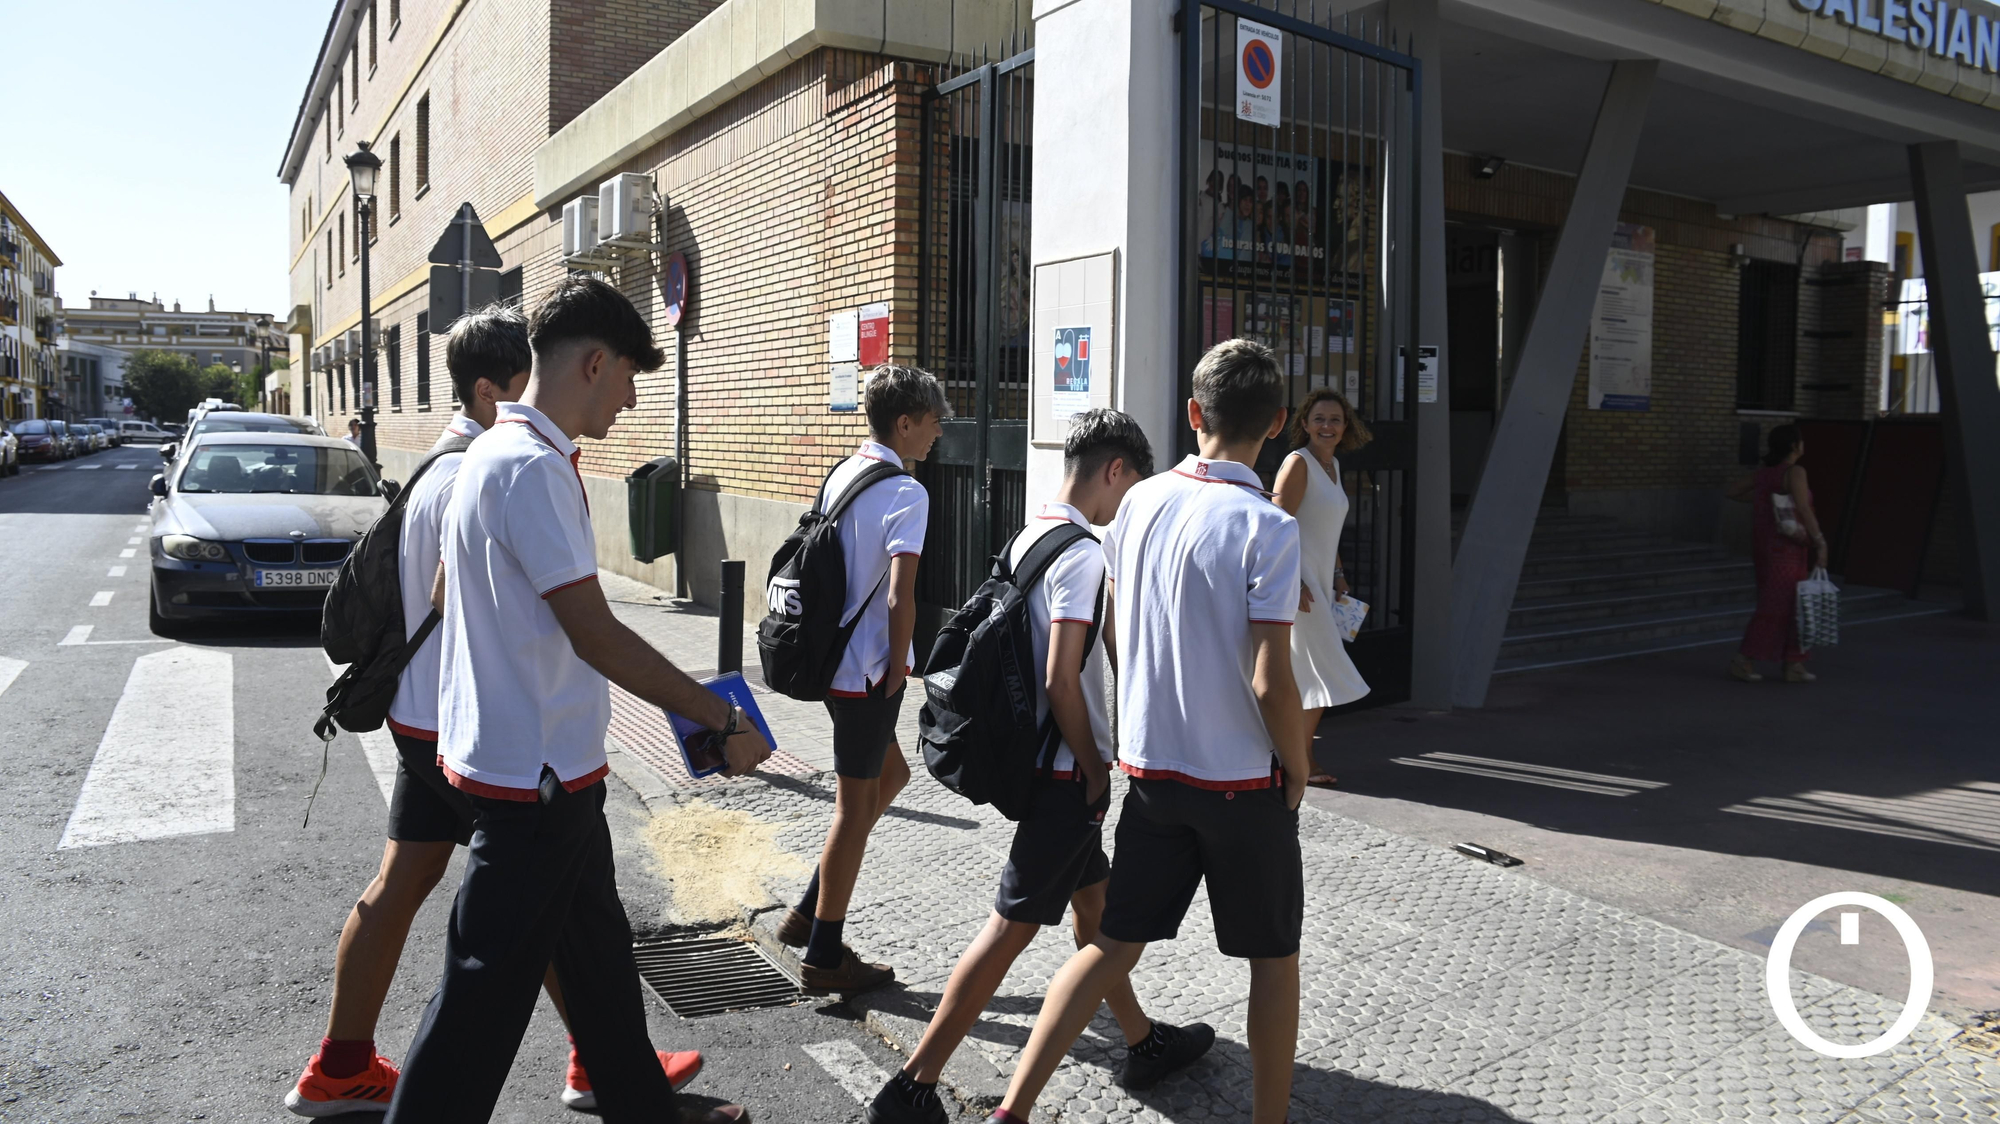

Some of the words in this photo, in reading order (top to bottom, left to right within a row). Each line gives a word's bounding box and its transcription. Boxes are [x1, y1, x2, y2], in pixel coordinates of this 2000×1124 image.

[1239, 23, 1255, 33] ENTRADA
[1797, 0, 2000, 73] LESIAN
[265, 572, 303, 585] 5398
[307, 572, 334, 585] DNC
